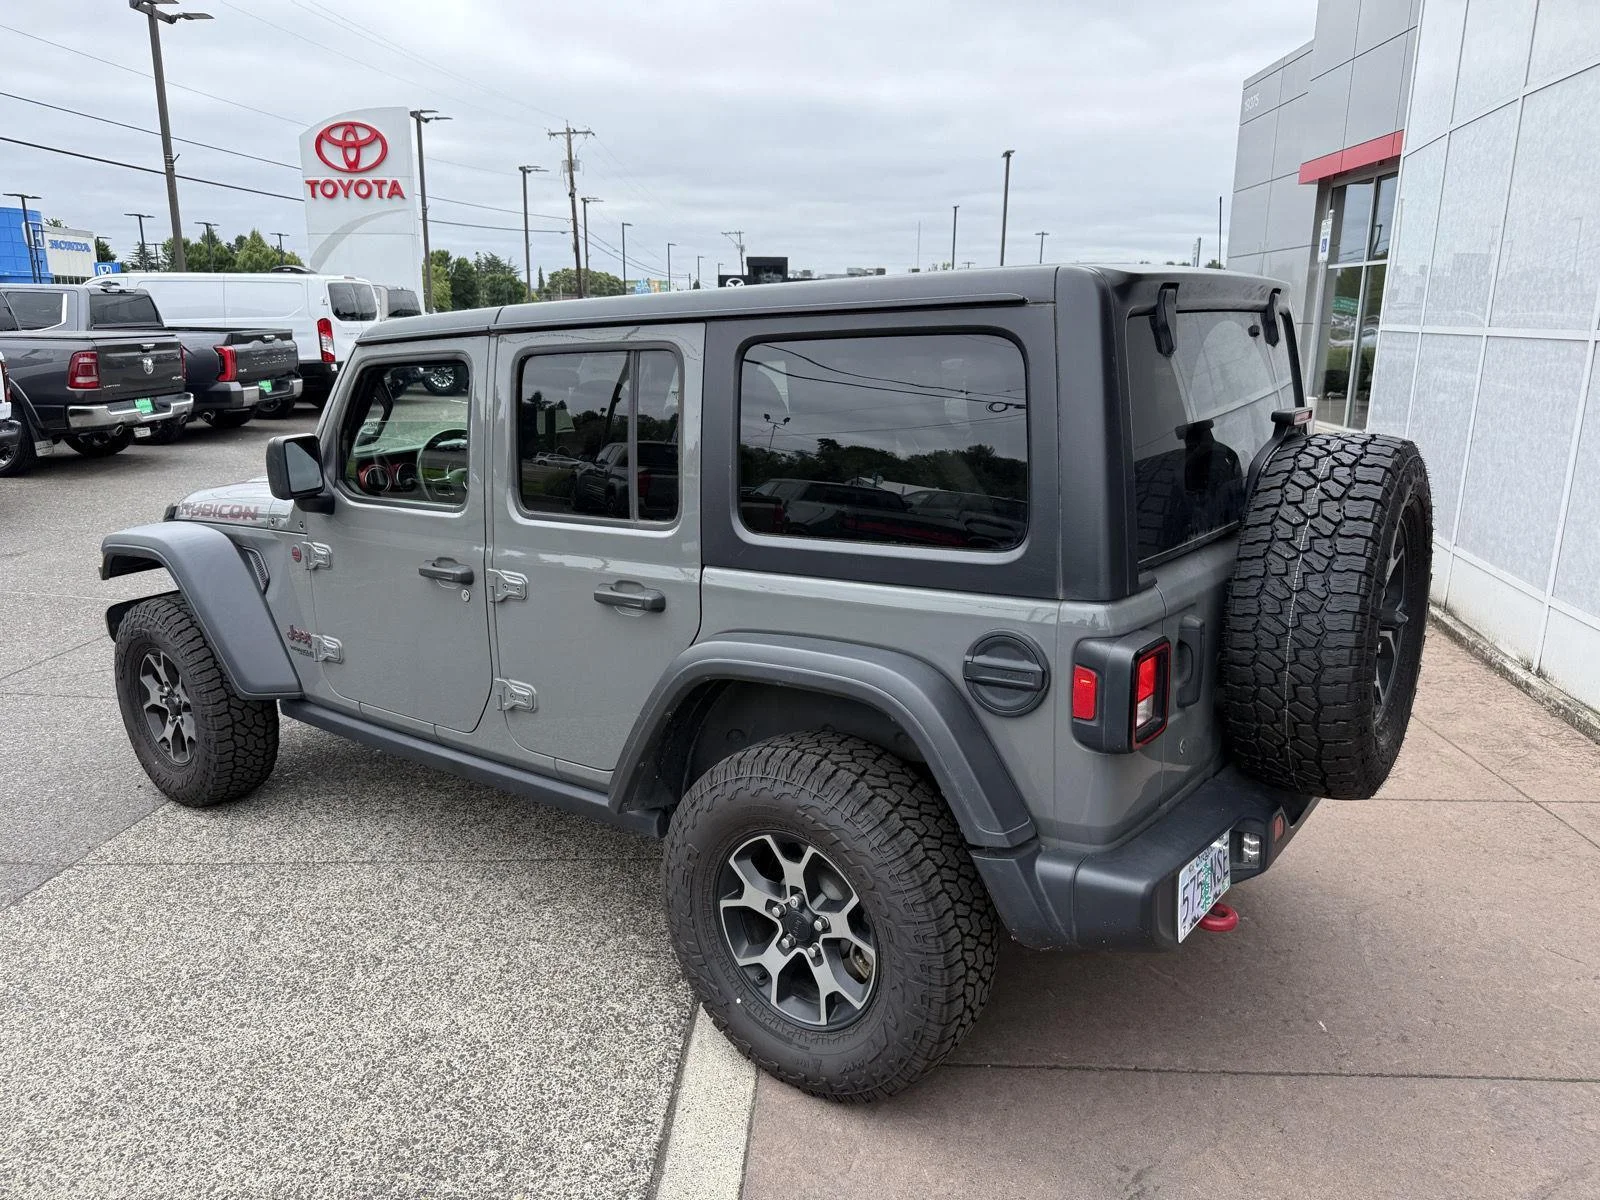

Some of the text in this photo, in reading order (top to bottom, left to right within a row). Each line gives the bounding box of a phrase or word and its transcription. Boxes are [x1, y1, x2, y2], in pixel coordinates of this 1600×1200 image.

[304, 178, 406, 200] TOYOTA
[48, 239, 92, 253] HONDA
[180, 501, 260, 521] RUBICON
[1181, 868, 1204, 923] 575
